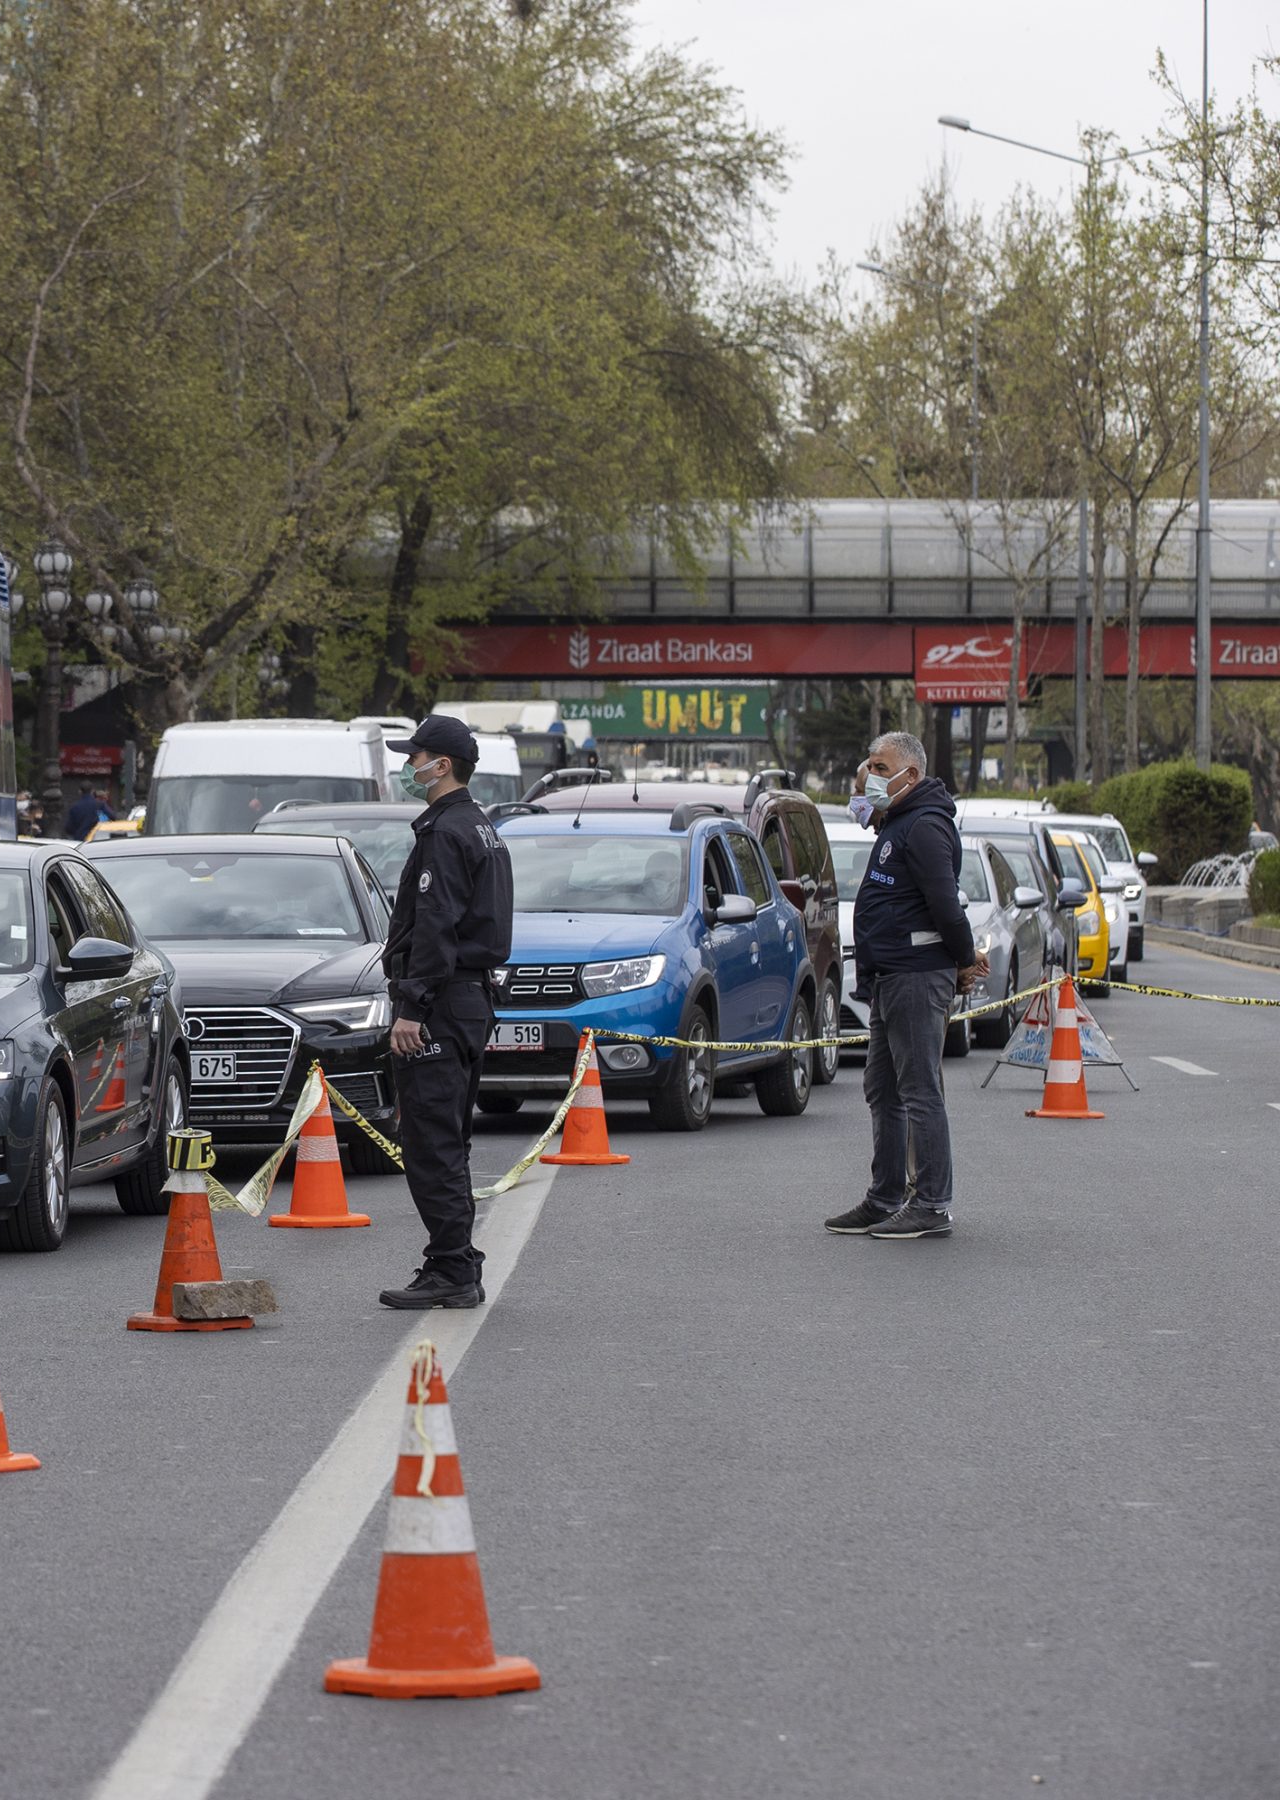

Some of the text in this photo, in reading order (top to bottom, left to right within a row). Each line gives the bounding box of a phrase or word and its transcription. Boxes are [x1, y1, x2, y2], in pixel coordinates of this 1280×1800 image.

[596, 637, 753, 663] Ziraat Bankası
[1219, 638, 1280, 665] Ziraa
[926, 687, 970, 700] KUTLU
[641, 688, 748, 735] UMUT
[514, 1025, 541, 1044] 519
[199, 1057, 232, 1077] 675
